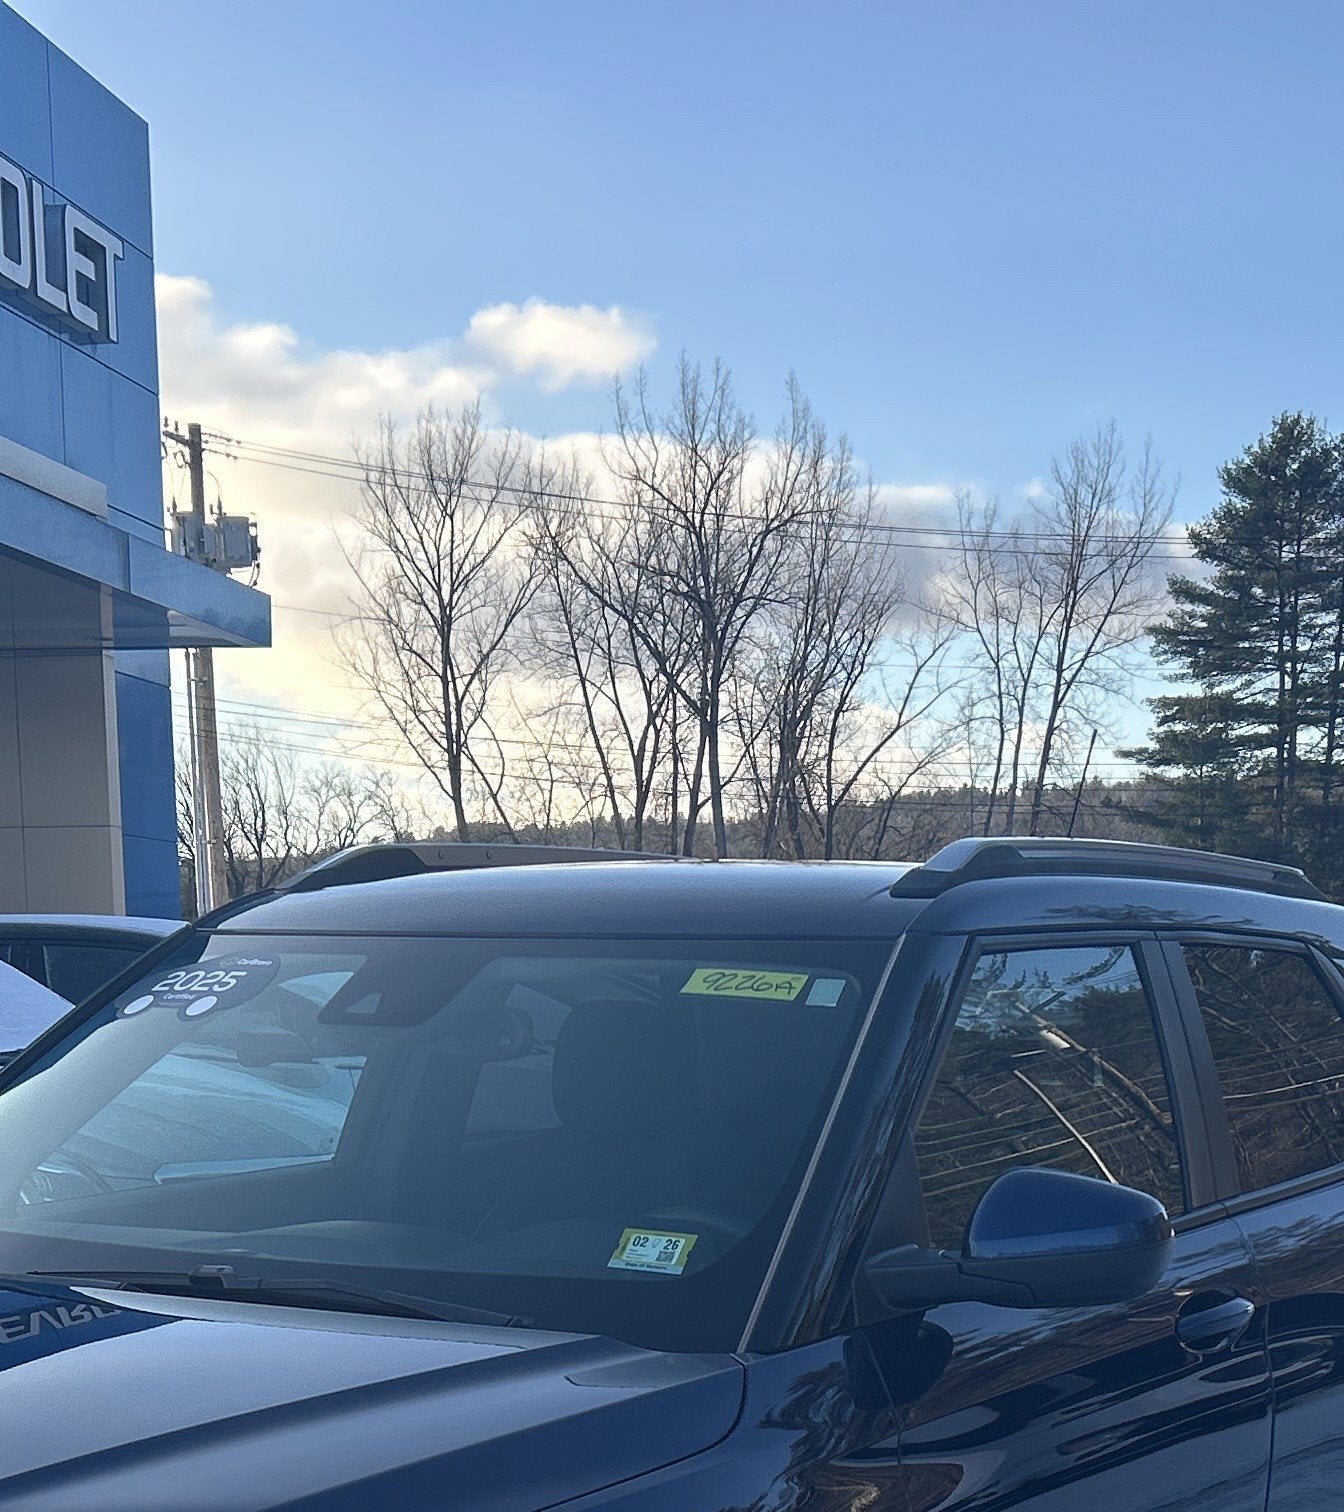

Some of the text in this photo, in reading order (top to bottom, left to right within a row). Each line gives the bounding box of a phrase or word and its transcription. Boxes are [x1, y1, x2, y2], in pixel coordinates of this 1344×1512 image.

[151, 970, 247, 992] 2025
[632, 1235, 680, 1251] 02 26
